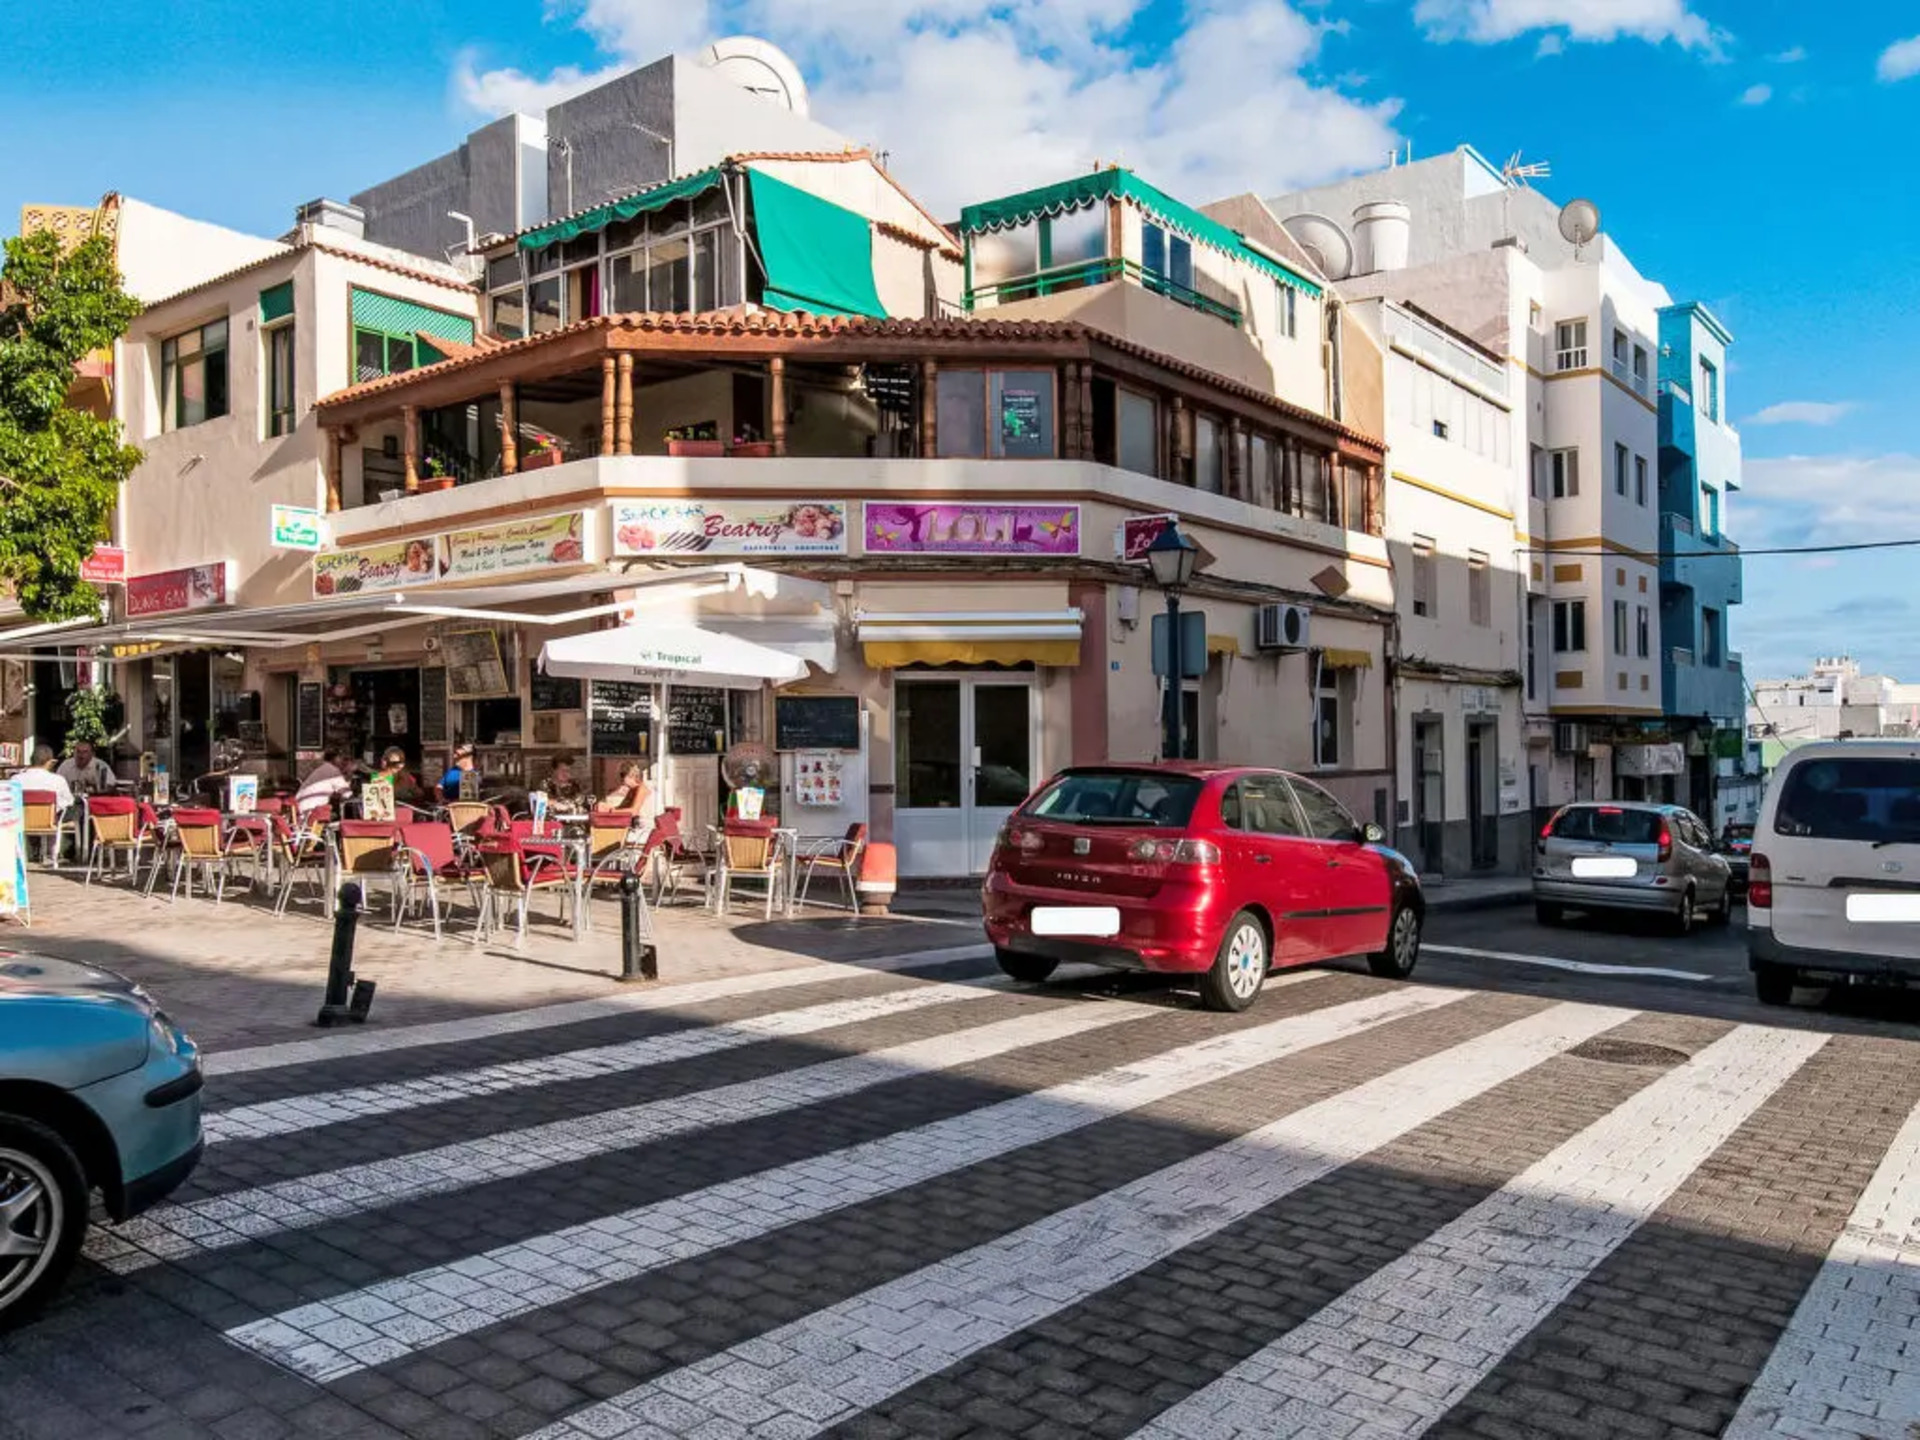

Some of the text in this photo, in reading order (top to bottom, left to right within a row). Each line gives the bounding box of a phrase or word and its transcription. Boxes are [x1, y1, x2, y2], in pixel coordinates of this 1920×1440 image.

[703, 514, 784, 544] Beatriz
[927, 510, 1011, 542] LOLI
[358, 557, 402, 580] Beatriz
[657, 651, 702, 665] Tropical
